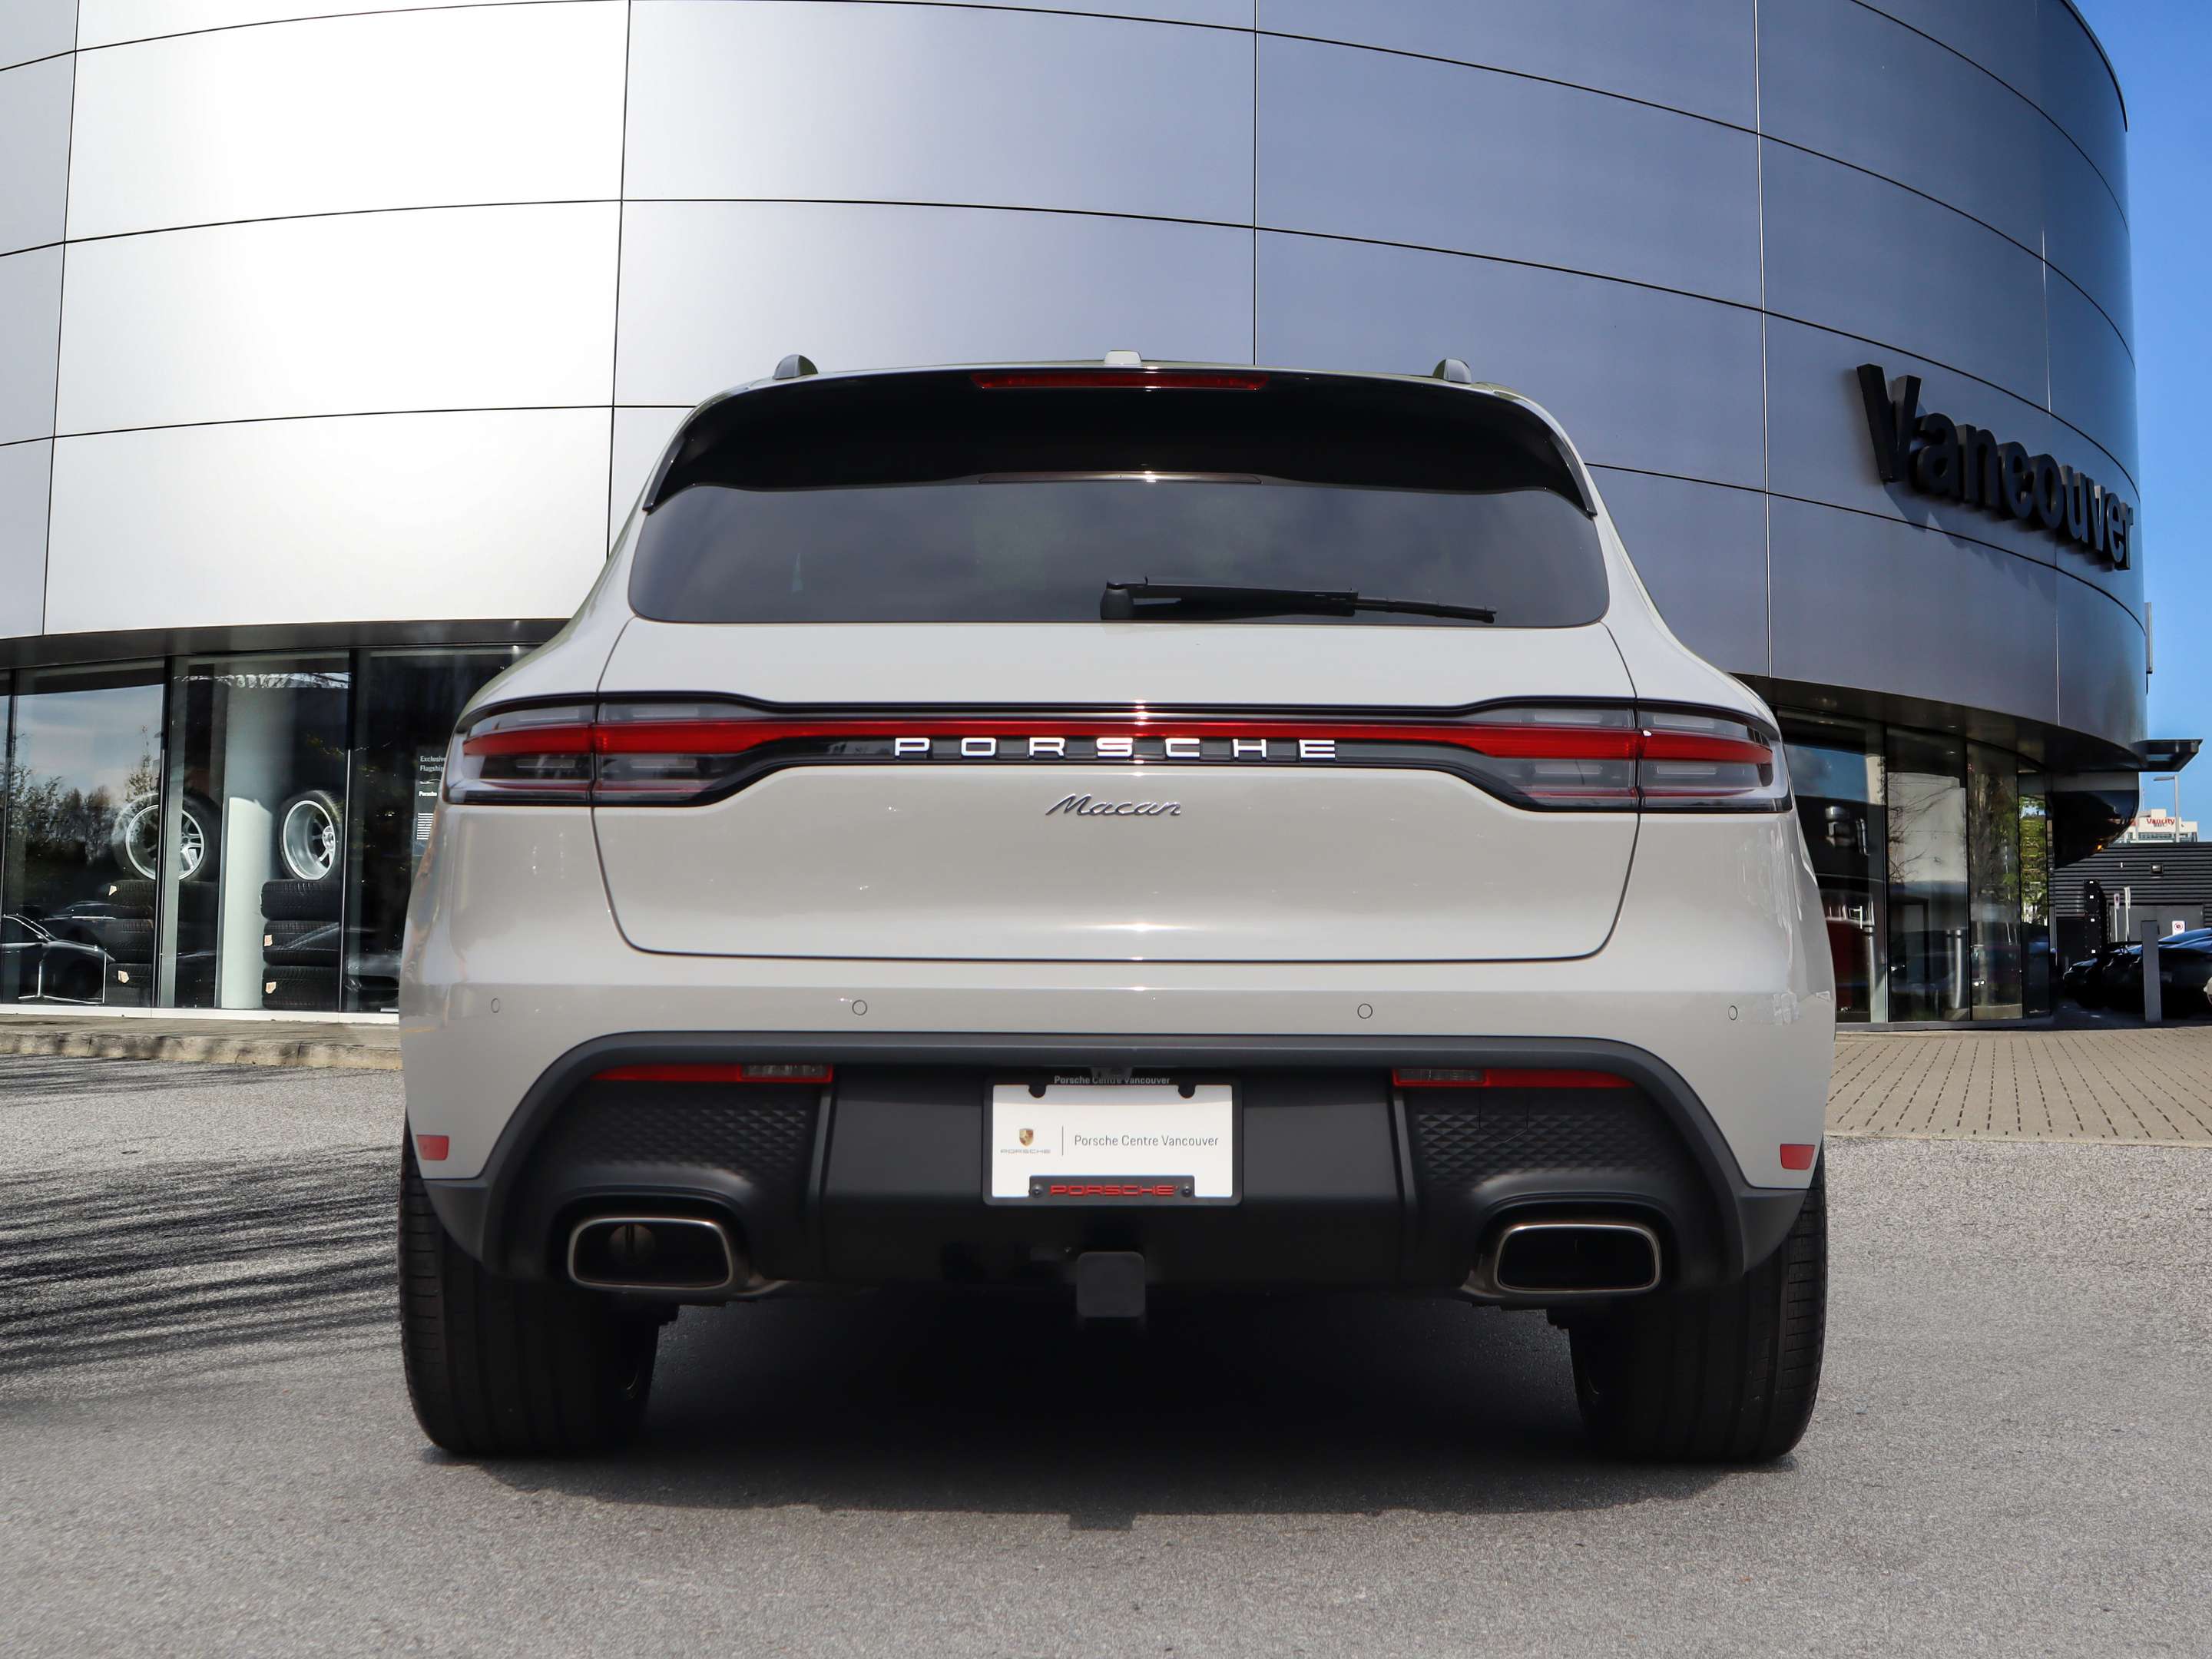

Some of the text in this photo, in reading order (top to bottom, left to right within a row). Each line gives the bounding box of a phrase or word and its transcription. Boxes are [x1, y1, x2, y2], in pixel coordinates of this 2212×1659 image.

[1857, 363, 2134, 571] Vancouver
[894, 737, 1336, 759] PORSCHE
[1045, 793, 1182, 816] Macan
[1054, 1075, 1091, 1084] Porsche
[1124, 1075, 1171, 1084] Vancouver
[1075, 1135, 1219, 1146] Porsche Centre Vancouver
[1049, 1185, 1176, 1197] PORSCHE
